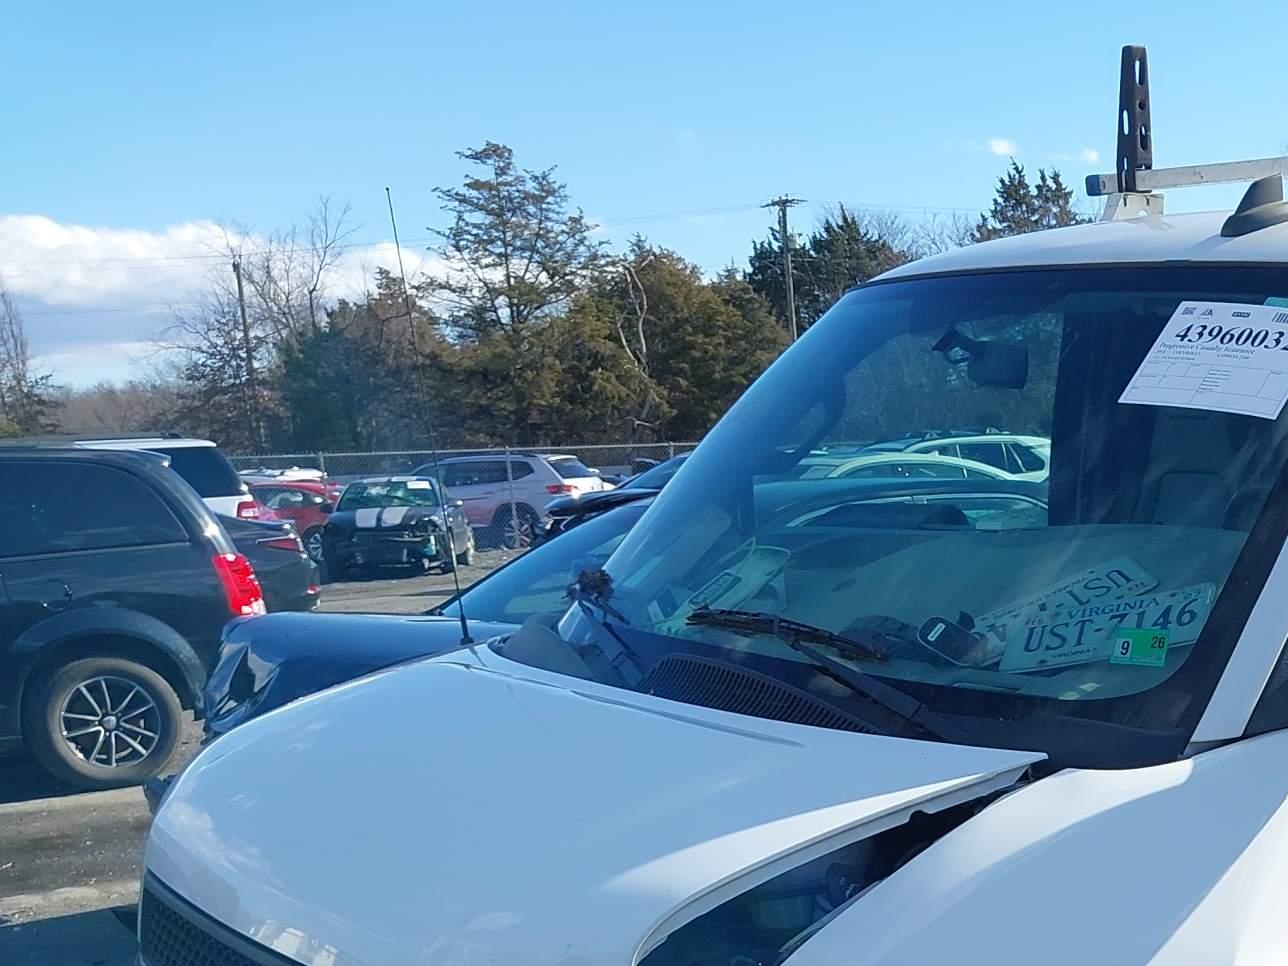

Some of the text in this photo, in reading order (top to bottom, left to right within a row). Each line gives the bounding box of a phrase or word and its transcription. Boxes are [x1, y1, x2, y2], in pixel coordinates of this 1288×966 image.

[1067, 597, 1160, 620] VIRGINIA
[1119, 640, 1131, 656] 9
[1150, 635, 1166, 650] 26
